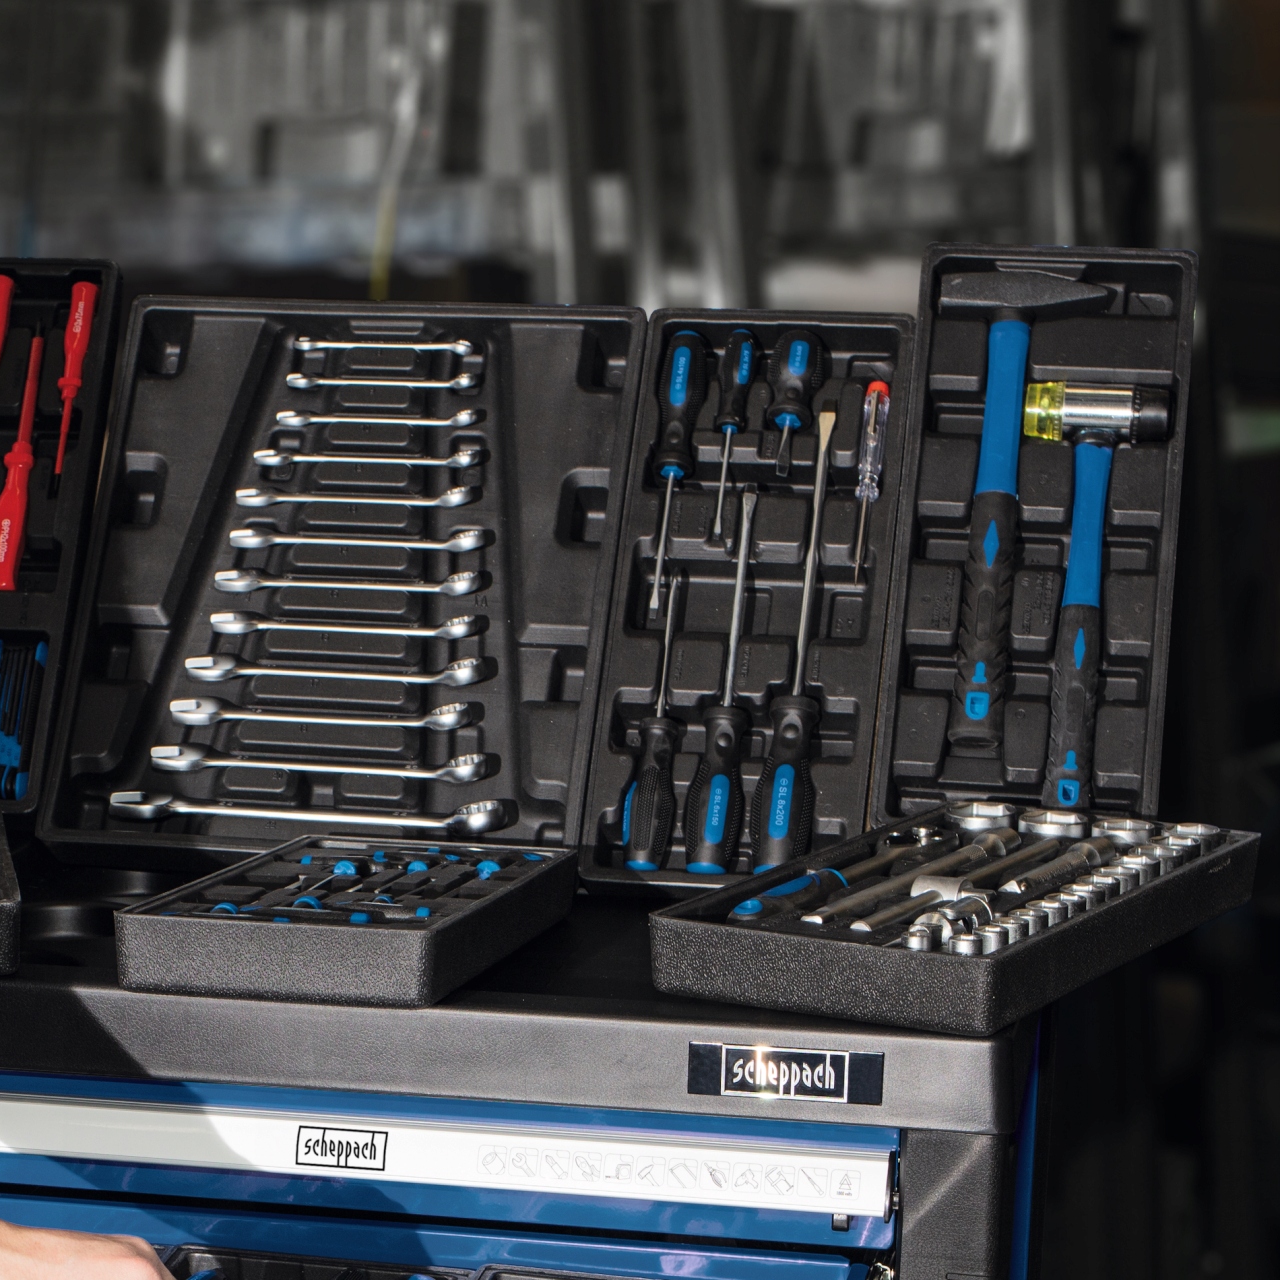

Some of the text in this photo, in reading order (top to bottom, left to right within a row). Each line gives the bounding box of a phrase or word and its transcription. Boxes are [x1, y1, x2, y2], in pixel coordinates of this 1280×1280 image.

[711, 805, 721, 826] 6x150
[775, 786, 787, 826] SL 8x200
[733, 1050, 835, 1096] scheppach
[305, 1130, 377, 1168] scheppach
